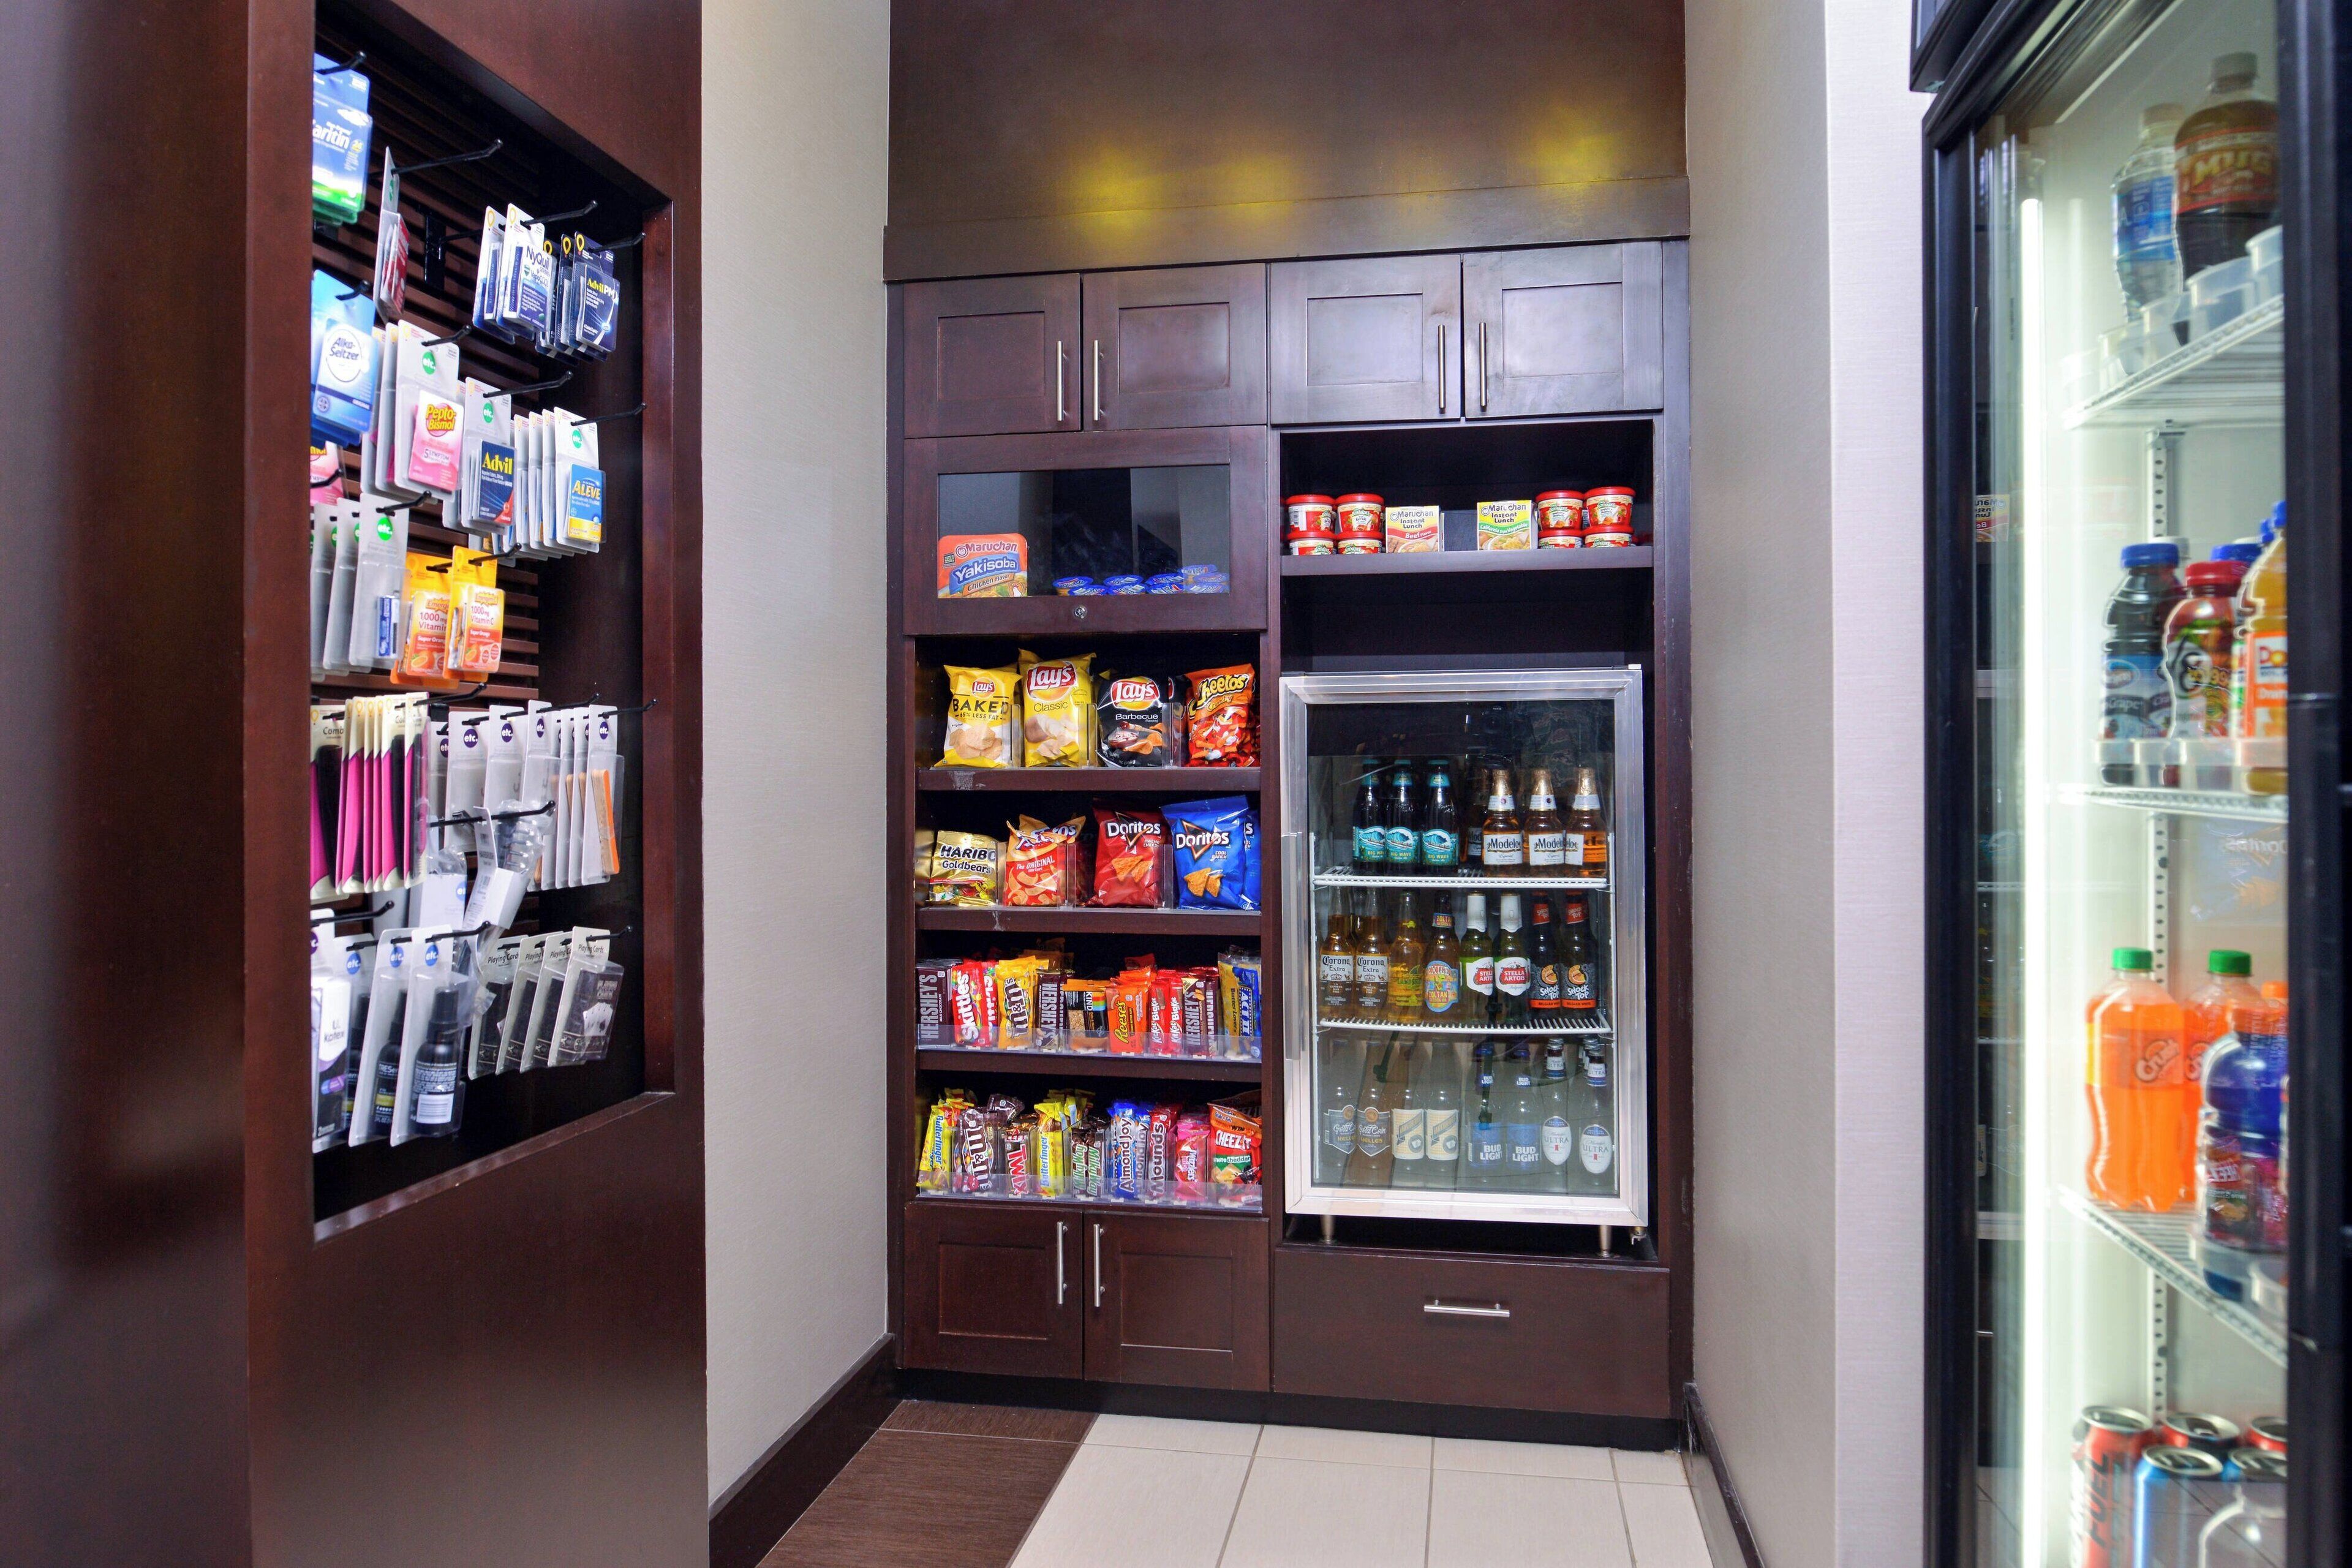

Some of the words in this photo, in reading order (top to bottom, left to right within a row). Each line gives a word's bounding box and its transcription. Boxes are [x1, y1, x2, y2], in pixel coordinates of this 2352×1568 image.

[312, 124, 351, 150] aritin
[527, 245, 549, 270] NyQuil
[329, 347, 360, 360] Seltzer
[423, 358, 435, 369] etc.
[426, 404, 457, 421] Pepto-
[429, 418, 456, 431] Bismol
[482, 452, 513, 475] Advil
[572, 480, 601, 500] ALEVE
[965, 541, 1018, 552] Maruchan
[955, 558, 1016, 582] Yakisoba
[968, 578, 993, 592] Chicken
[995, 574, 1011, 582] Flavor
[428, 601, 449, 609] Emerg
[470, 616, 489, 625] Vitamin
[1030, 663, 1077, 691] Lay's
[973, 680, 995, 693] Lay's
[1116, 682, 1155, 703] Lay's
[953, 699, 1009, 713] BAKED
[1033, 701, 1068, 712] Classic
[464, 733, 478, 742] etc.
[502, 729, 513, 737] etc.
[1107, 823, 1161, 837] Doritos
[1176, 831, 1229, 849] Doritos
[1490, 838, 1519, 849] Modelo
[940, 845, 996, 861] HARIBO
[942, 860, 992, 874] Goldbears
[1026, 856, 1055, 869] ORIGINAL
[525, 951, 542, 960] Playing
[551, 949, 567, 958] Playing
[578, 944, 593, 954] Playing
[347, 959, 361, 969] etc.
[488, 954, 507, 964] Playing
[507, 951, 519, 960] Card
[1322, 956, 1351, 966] Corona
[1357, 956, 1385, 967] Corona
[1567, 984, 1589, 996] SHOCK
[1577, 991, 1590, 1000] TOP
[919, 974, 938, 1039] HERSHEY'S
[956, 973, 979, 1040] Skittles
[1041, 983, 1058, 1039] HERSHEY'S
[1114, 1000, 1129, 1044] Reese's
[1185, 991, 1201, 1046] HERSHEY'S
[1119, 1118, 1133, 1141] Joy
[935, 1115, 944, 1165] Butterfinger
[1483, 1144, 1501, 1153] BUD
[1515, 1146, 1536, 1155] BUD
[1039, 1136, 1050, 1187] Butterfinger
[1150, 1122, 1165, 1194] Mounds
[1512, 1153, 1540, 1162] LIGHT
[1007, 1144, 1030, 1194] TWIX
[1119, 1139, 1134, 1193] Almond
